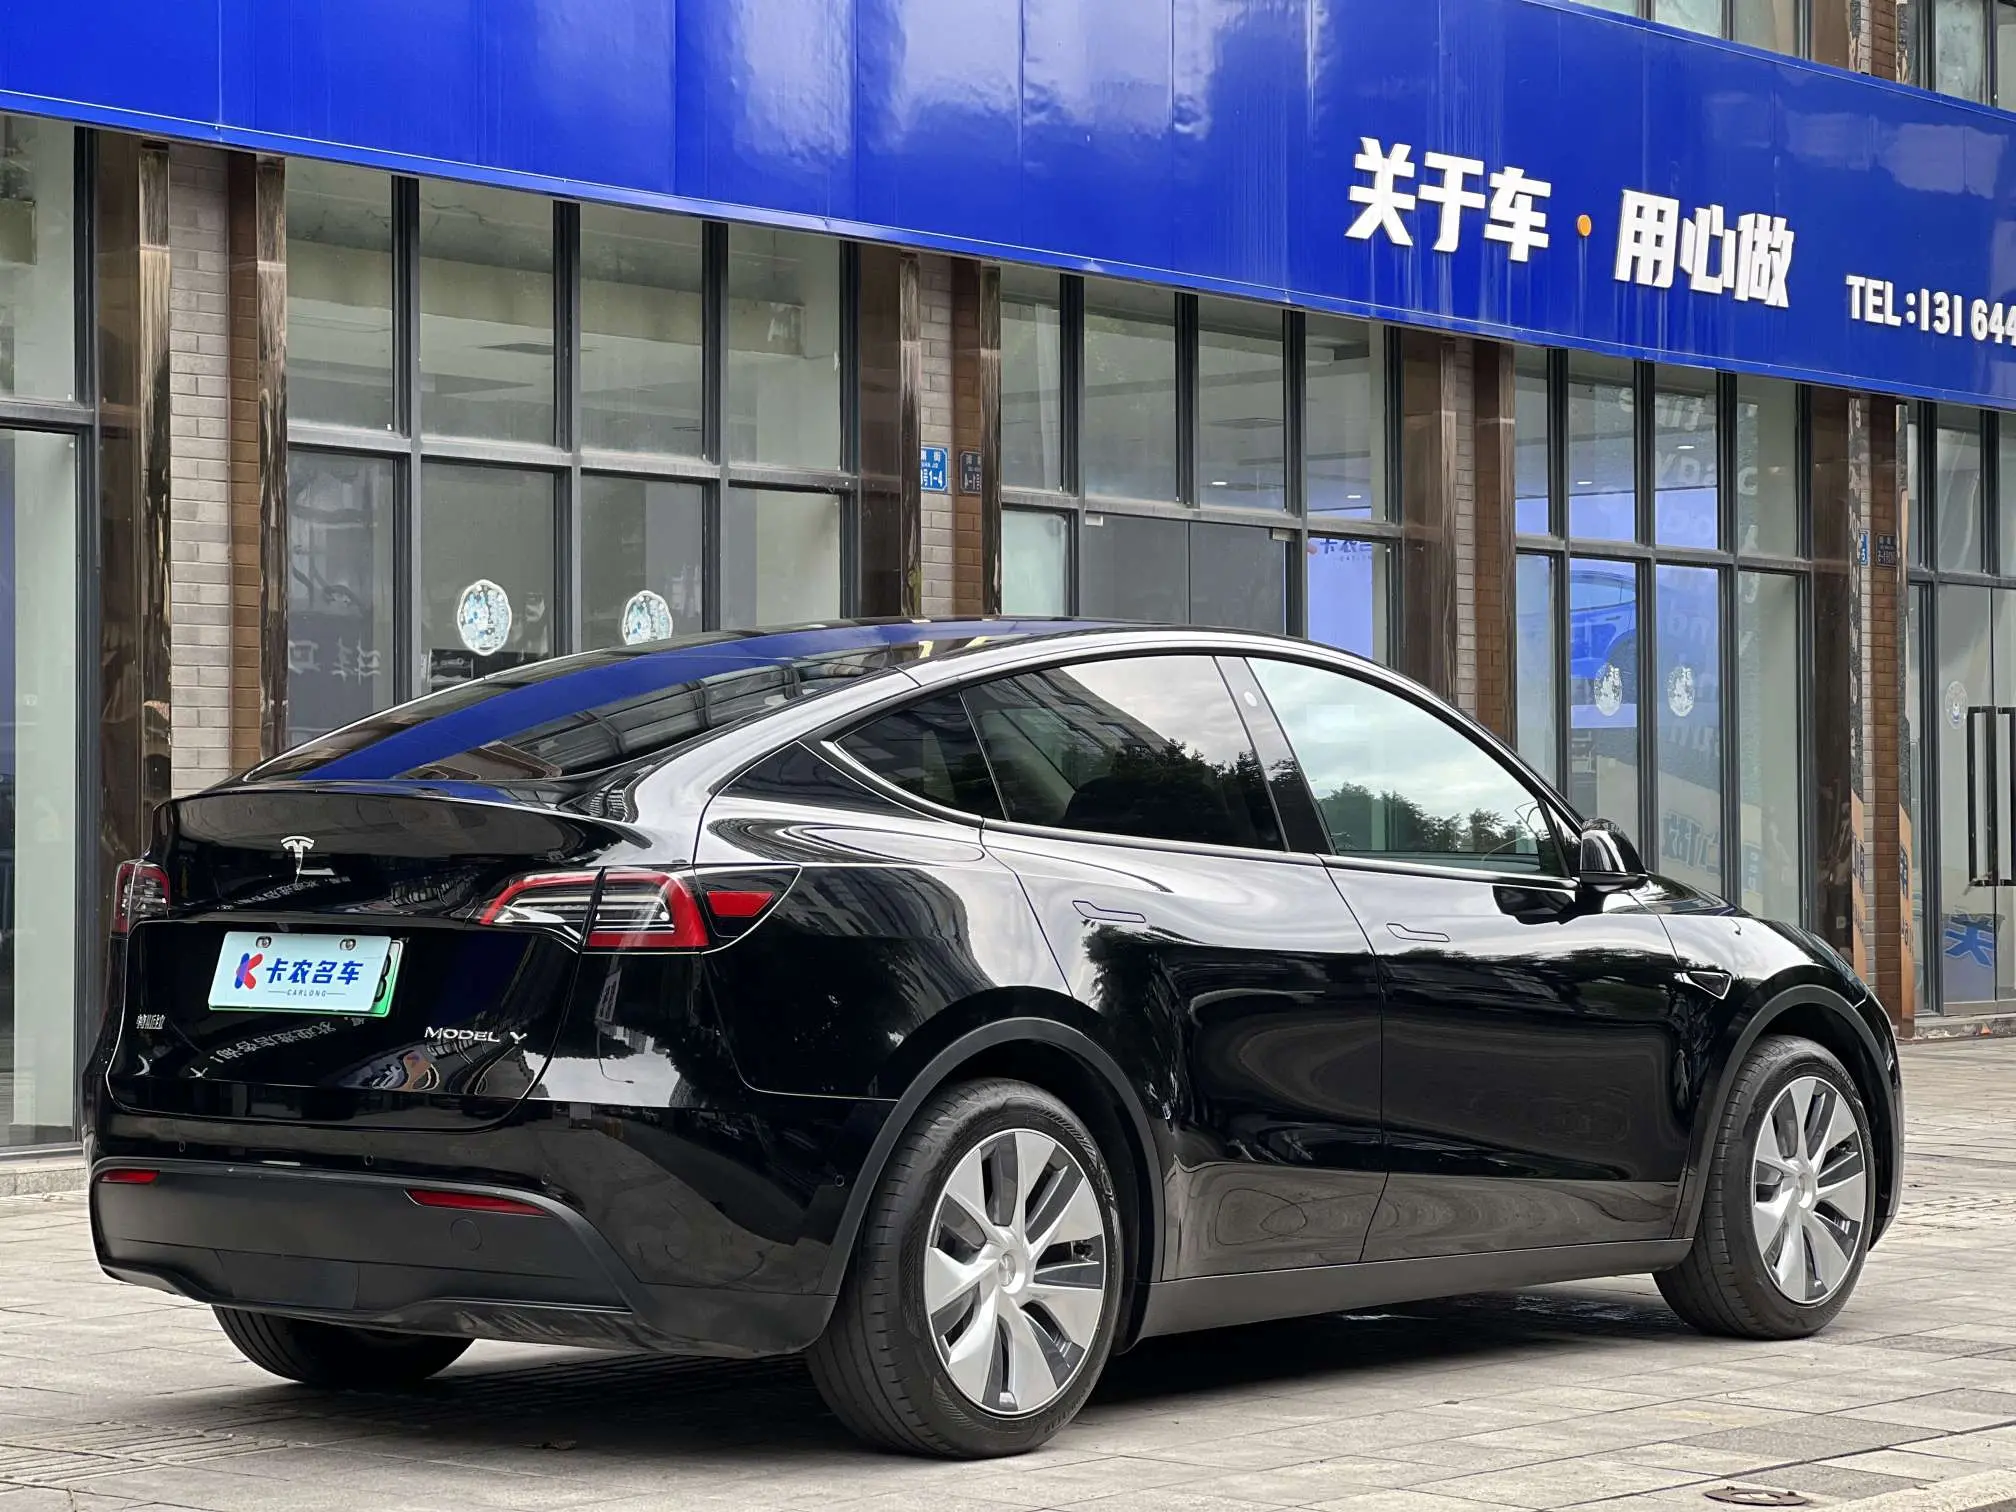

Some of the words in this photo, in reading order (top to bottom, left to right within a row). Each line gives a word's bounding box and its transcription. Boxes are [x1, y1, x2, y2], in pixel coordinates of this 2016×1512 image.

[266, 958, 363, 986] 卡农名车
[286, 988, 327, 998] CARLONG
[424, 1026, 501, 1043] MODEL
[509, 1031, 528, 1045] Y
